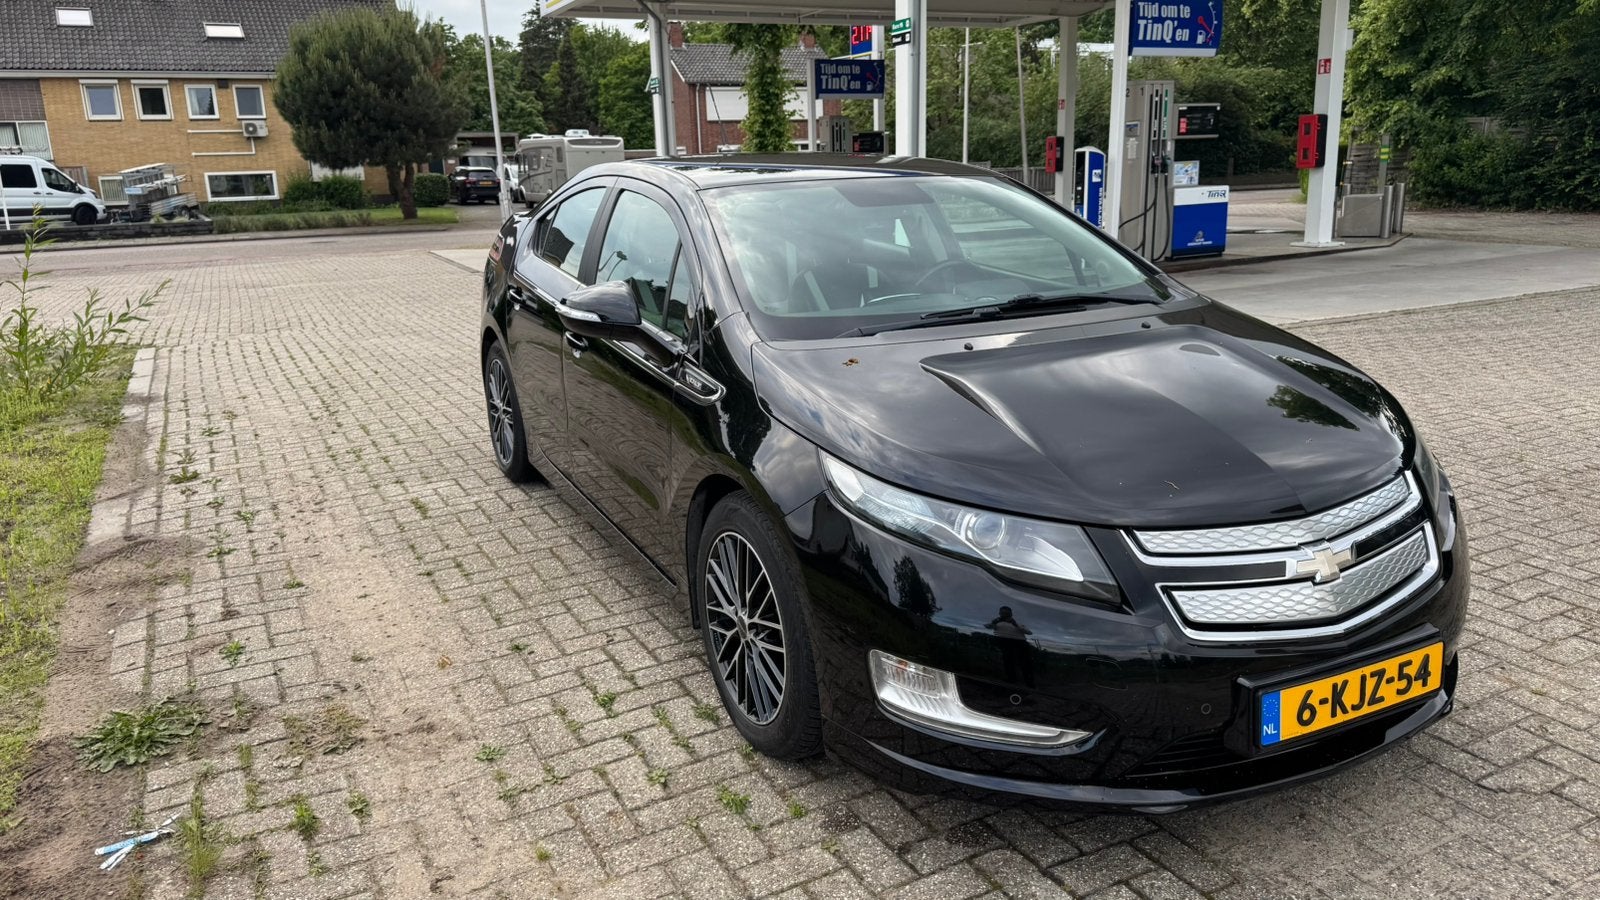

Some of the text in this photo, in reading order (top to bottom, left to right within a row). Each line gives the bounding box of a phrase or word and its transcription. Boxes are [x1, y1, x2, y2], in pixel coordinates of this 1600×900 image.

[1138, 2, 1191, 18] Tijd om te
[820, 64, 861, 75] Tijd om te
[1297, 653, 1431, 726] 6-KJZ-54
[1263, 723, 1278, 736] NL
